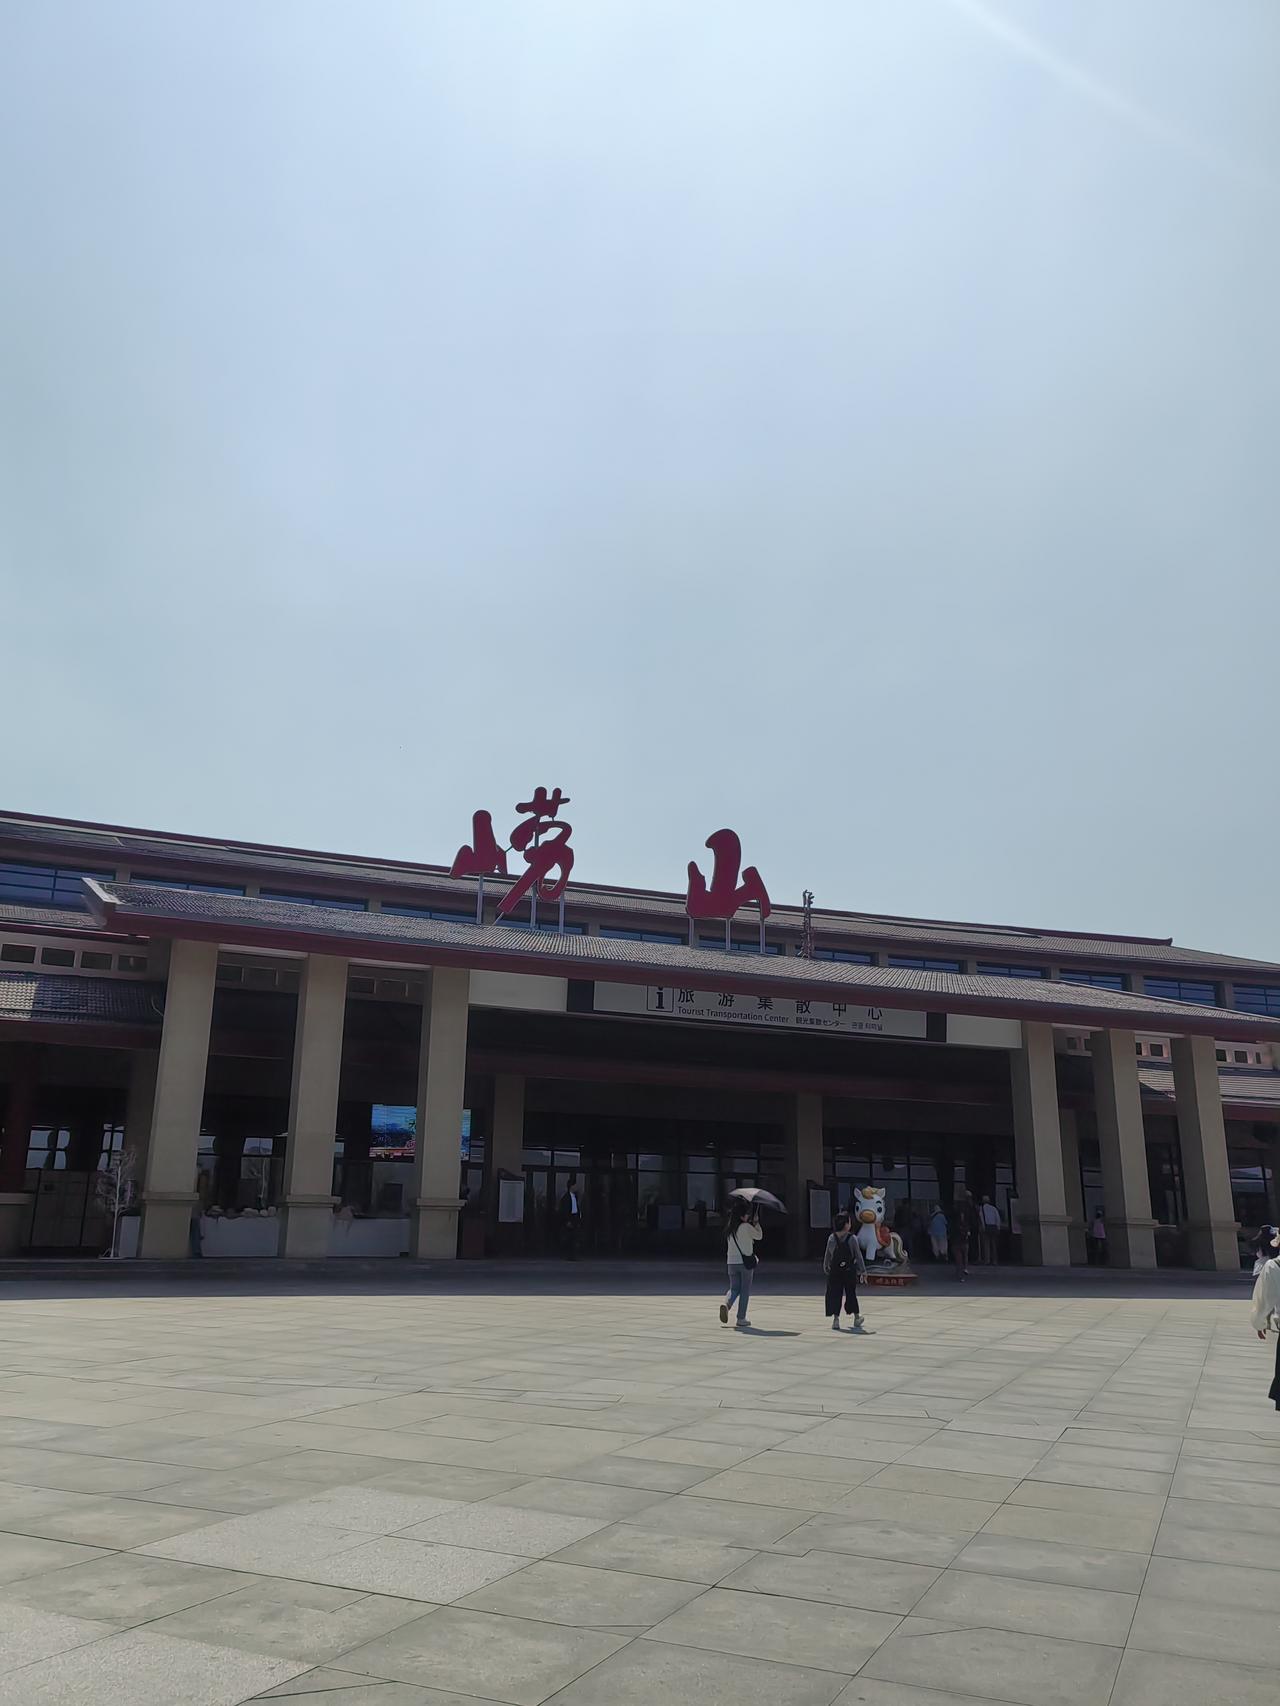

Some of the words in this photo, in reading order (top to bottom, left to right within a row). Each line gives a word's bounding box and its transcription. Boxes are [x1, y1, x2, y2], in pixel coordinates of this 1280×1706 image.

[677, 1006, 704, 1017] Tourist
[706, 1008, 763, 1021] Transportation
[764, 1013, 790, 1024] Center
[678, 988, 883, 1020] 旅游集散中心
